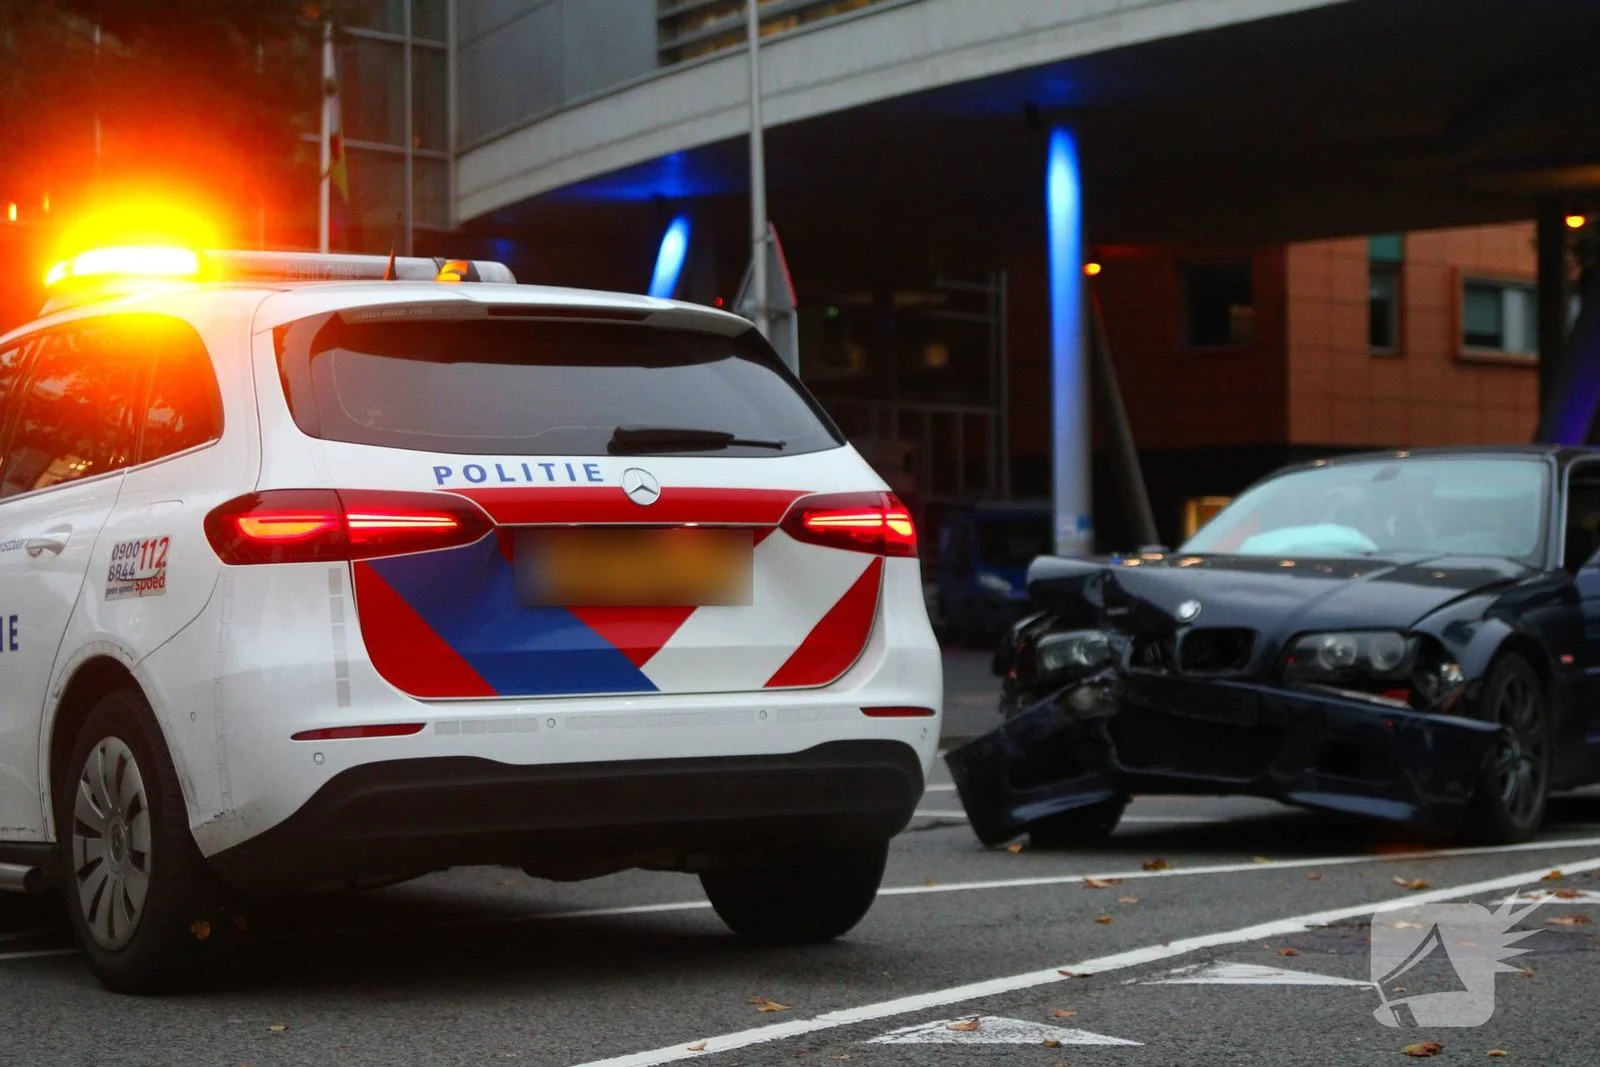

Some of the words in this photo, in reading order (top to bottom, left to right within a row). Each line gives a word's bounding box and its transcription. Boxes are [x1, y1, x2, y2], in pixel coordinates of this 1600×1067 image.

[432, 463, 604, 486] POLITIE
[111, 541, 140, 561] 0900
[140, 536, 169, 570] 112
[108, 562, 135, 582] 8844
[135, 570, 166, 597] spoed
